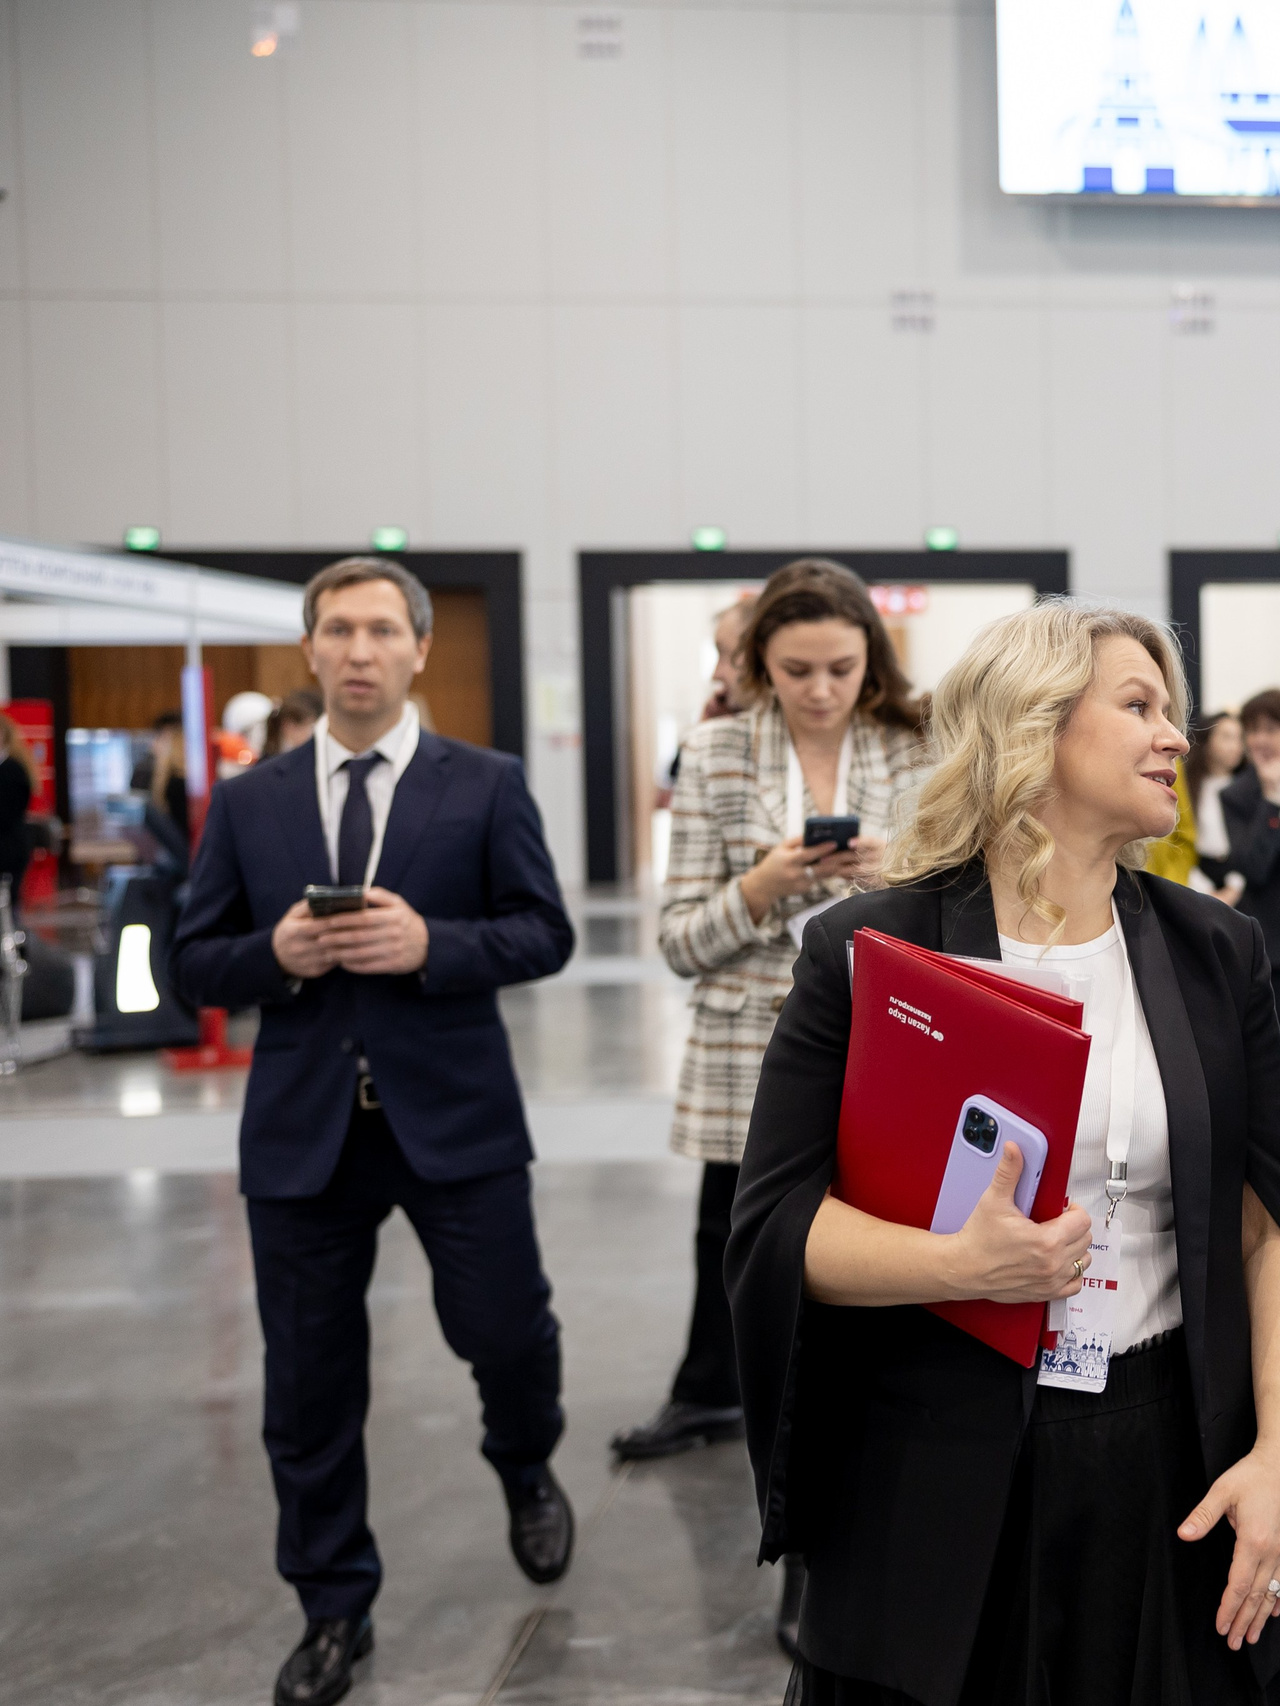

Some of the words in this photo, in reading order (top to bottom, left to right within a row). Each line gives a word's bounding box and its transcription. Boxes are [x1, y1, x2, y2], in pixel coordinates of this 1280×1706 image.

[888, 1008, 907, 1023] Expo
[889, 996, 931, 1023] kazanexpo.ru
[907, 1017, 930, 1035] Kazan
